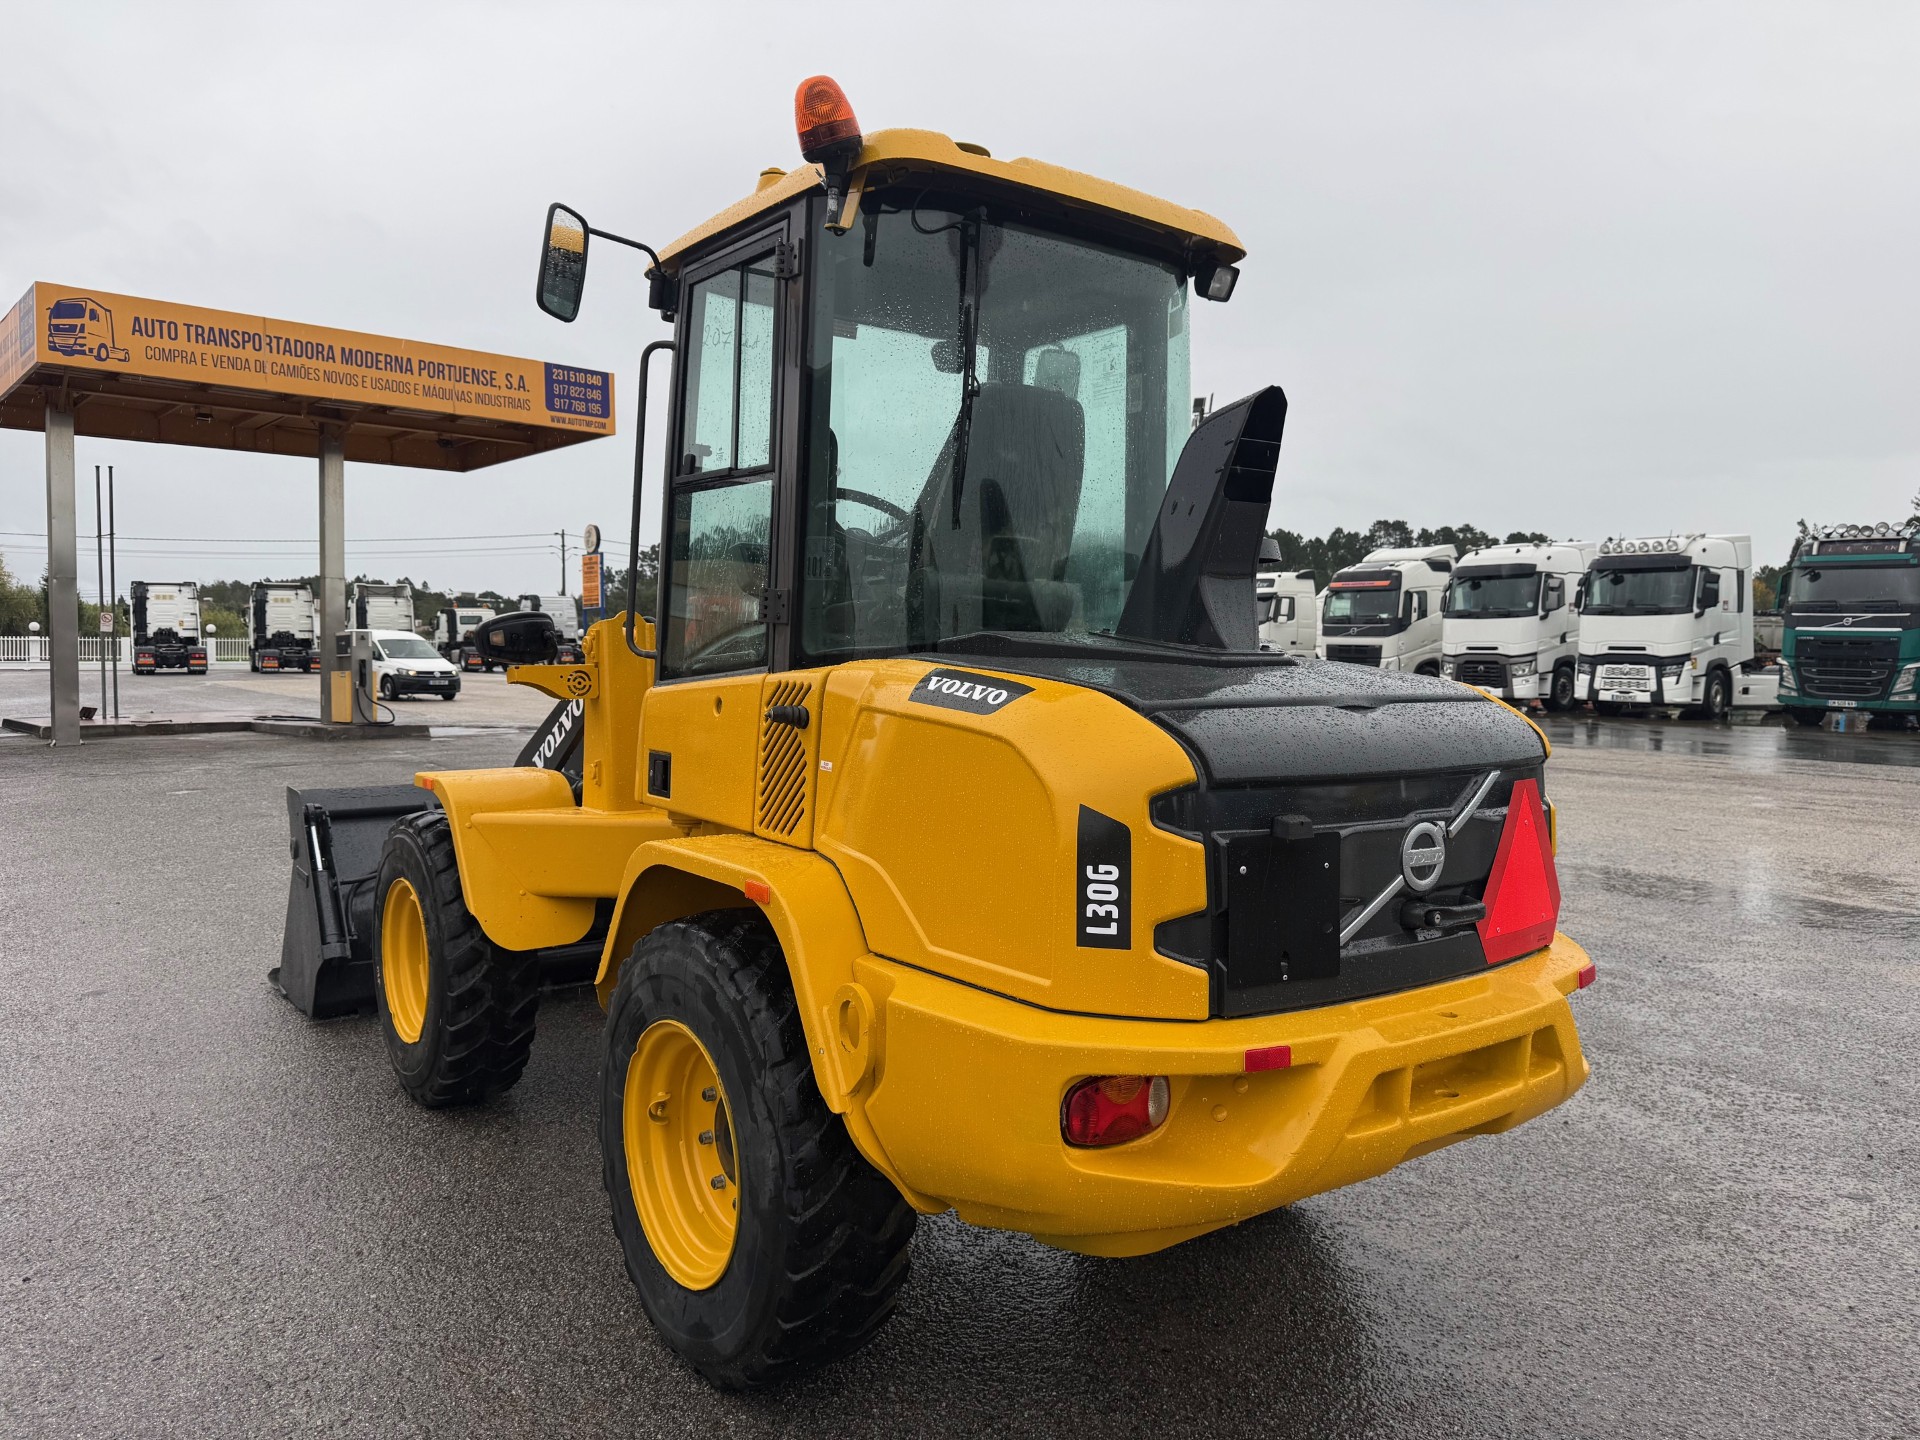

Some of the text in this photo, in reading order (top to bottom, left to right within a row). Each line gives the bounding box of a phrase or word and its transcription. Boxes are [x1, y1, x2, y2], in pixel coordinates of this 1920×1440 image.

[131, 316, 530, 393] AUTO TRANSPORTADORA MODERNA PORTUENSE, S.A.
[145, 345, 197, 366] COMPRA
[201, 352, 208, 367] E
[211, 353, 251, 373] VENDA
[271, 361, 320, 382] CAMIÕES
[323, 369, 359, 387] NOVOS
[361, 375, 368, 389] E
[370, 376, 411, 395] USADOS
[413, 383, 420, 396] E
[422, 383, 473, 404] MÁQUINAS
[475, 392, 531, 411] INDUSTRIAIS
[552, 368, 602, 386] 231 510 840
[553, 383, 602, 401] 917 822 846
[554, 398, 602, 415] 917 768 195
[550, 415, 607, 430] WWW.AUTOTMP.COM
[926, 676, 1008, 705] VOLVO
[531, 697, 584, 768] VOLVO
[1085, 864, 1120, 935] L30G
